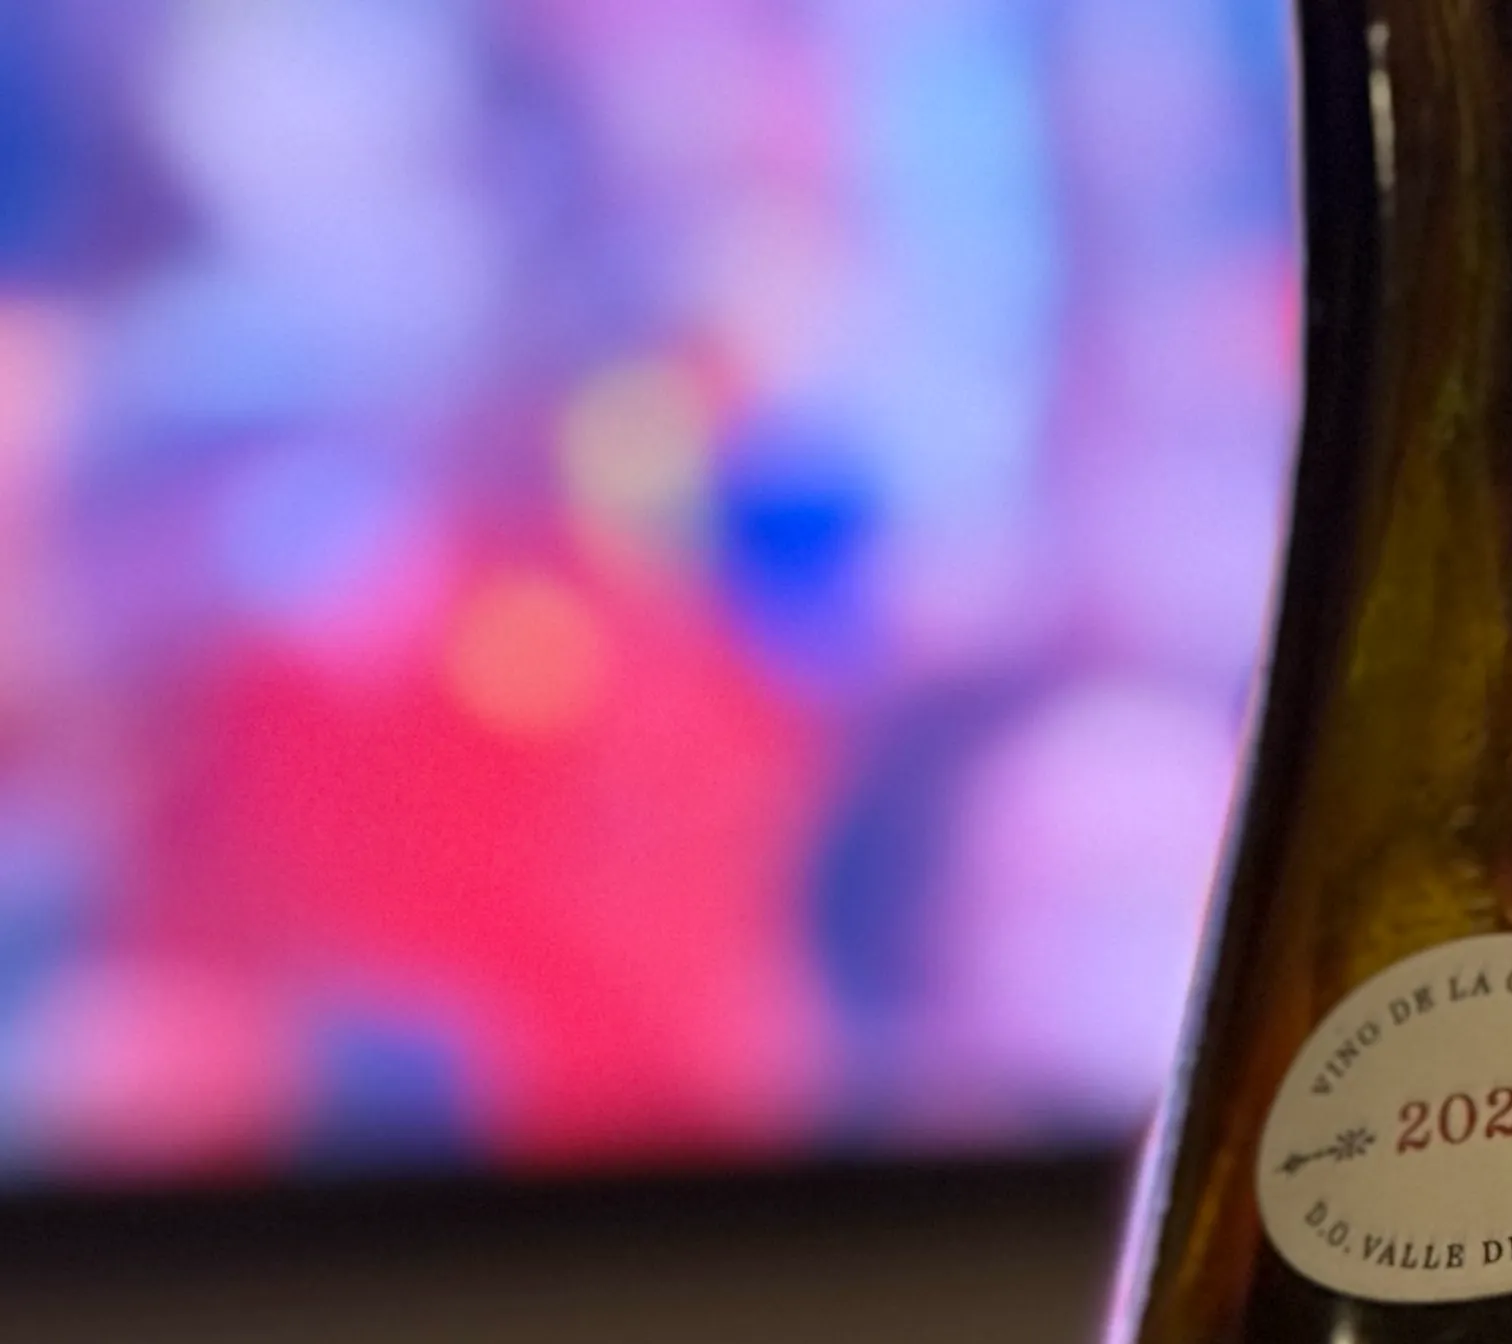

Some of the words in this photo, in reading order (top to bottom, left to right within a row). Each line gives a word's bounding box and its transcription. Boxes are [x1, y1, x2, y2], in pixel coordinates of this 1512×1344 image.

[1311, 1024, 1381, 1096] VINO
[1391, 985, 1435, 1026] DE
[1448, 973, 1492, 1002] LA
[1305, 1201, 1352, 1256] D.O.
[1362, 1236, 1463, 1270] VALLE
